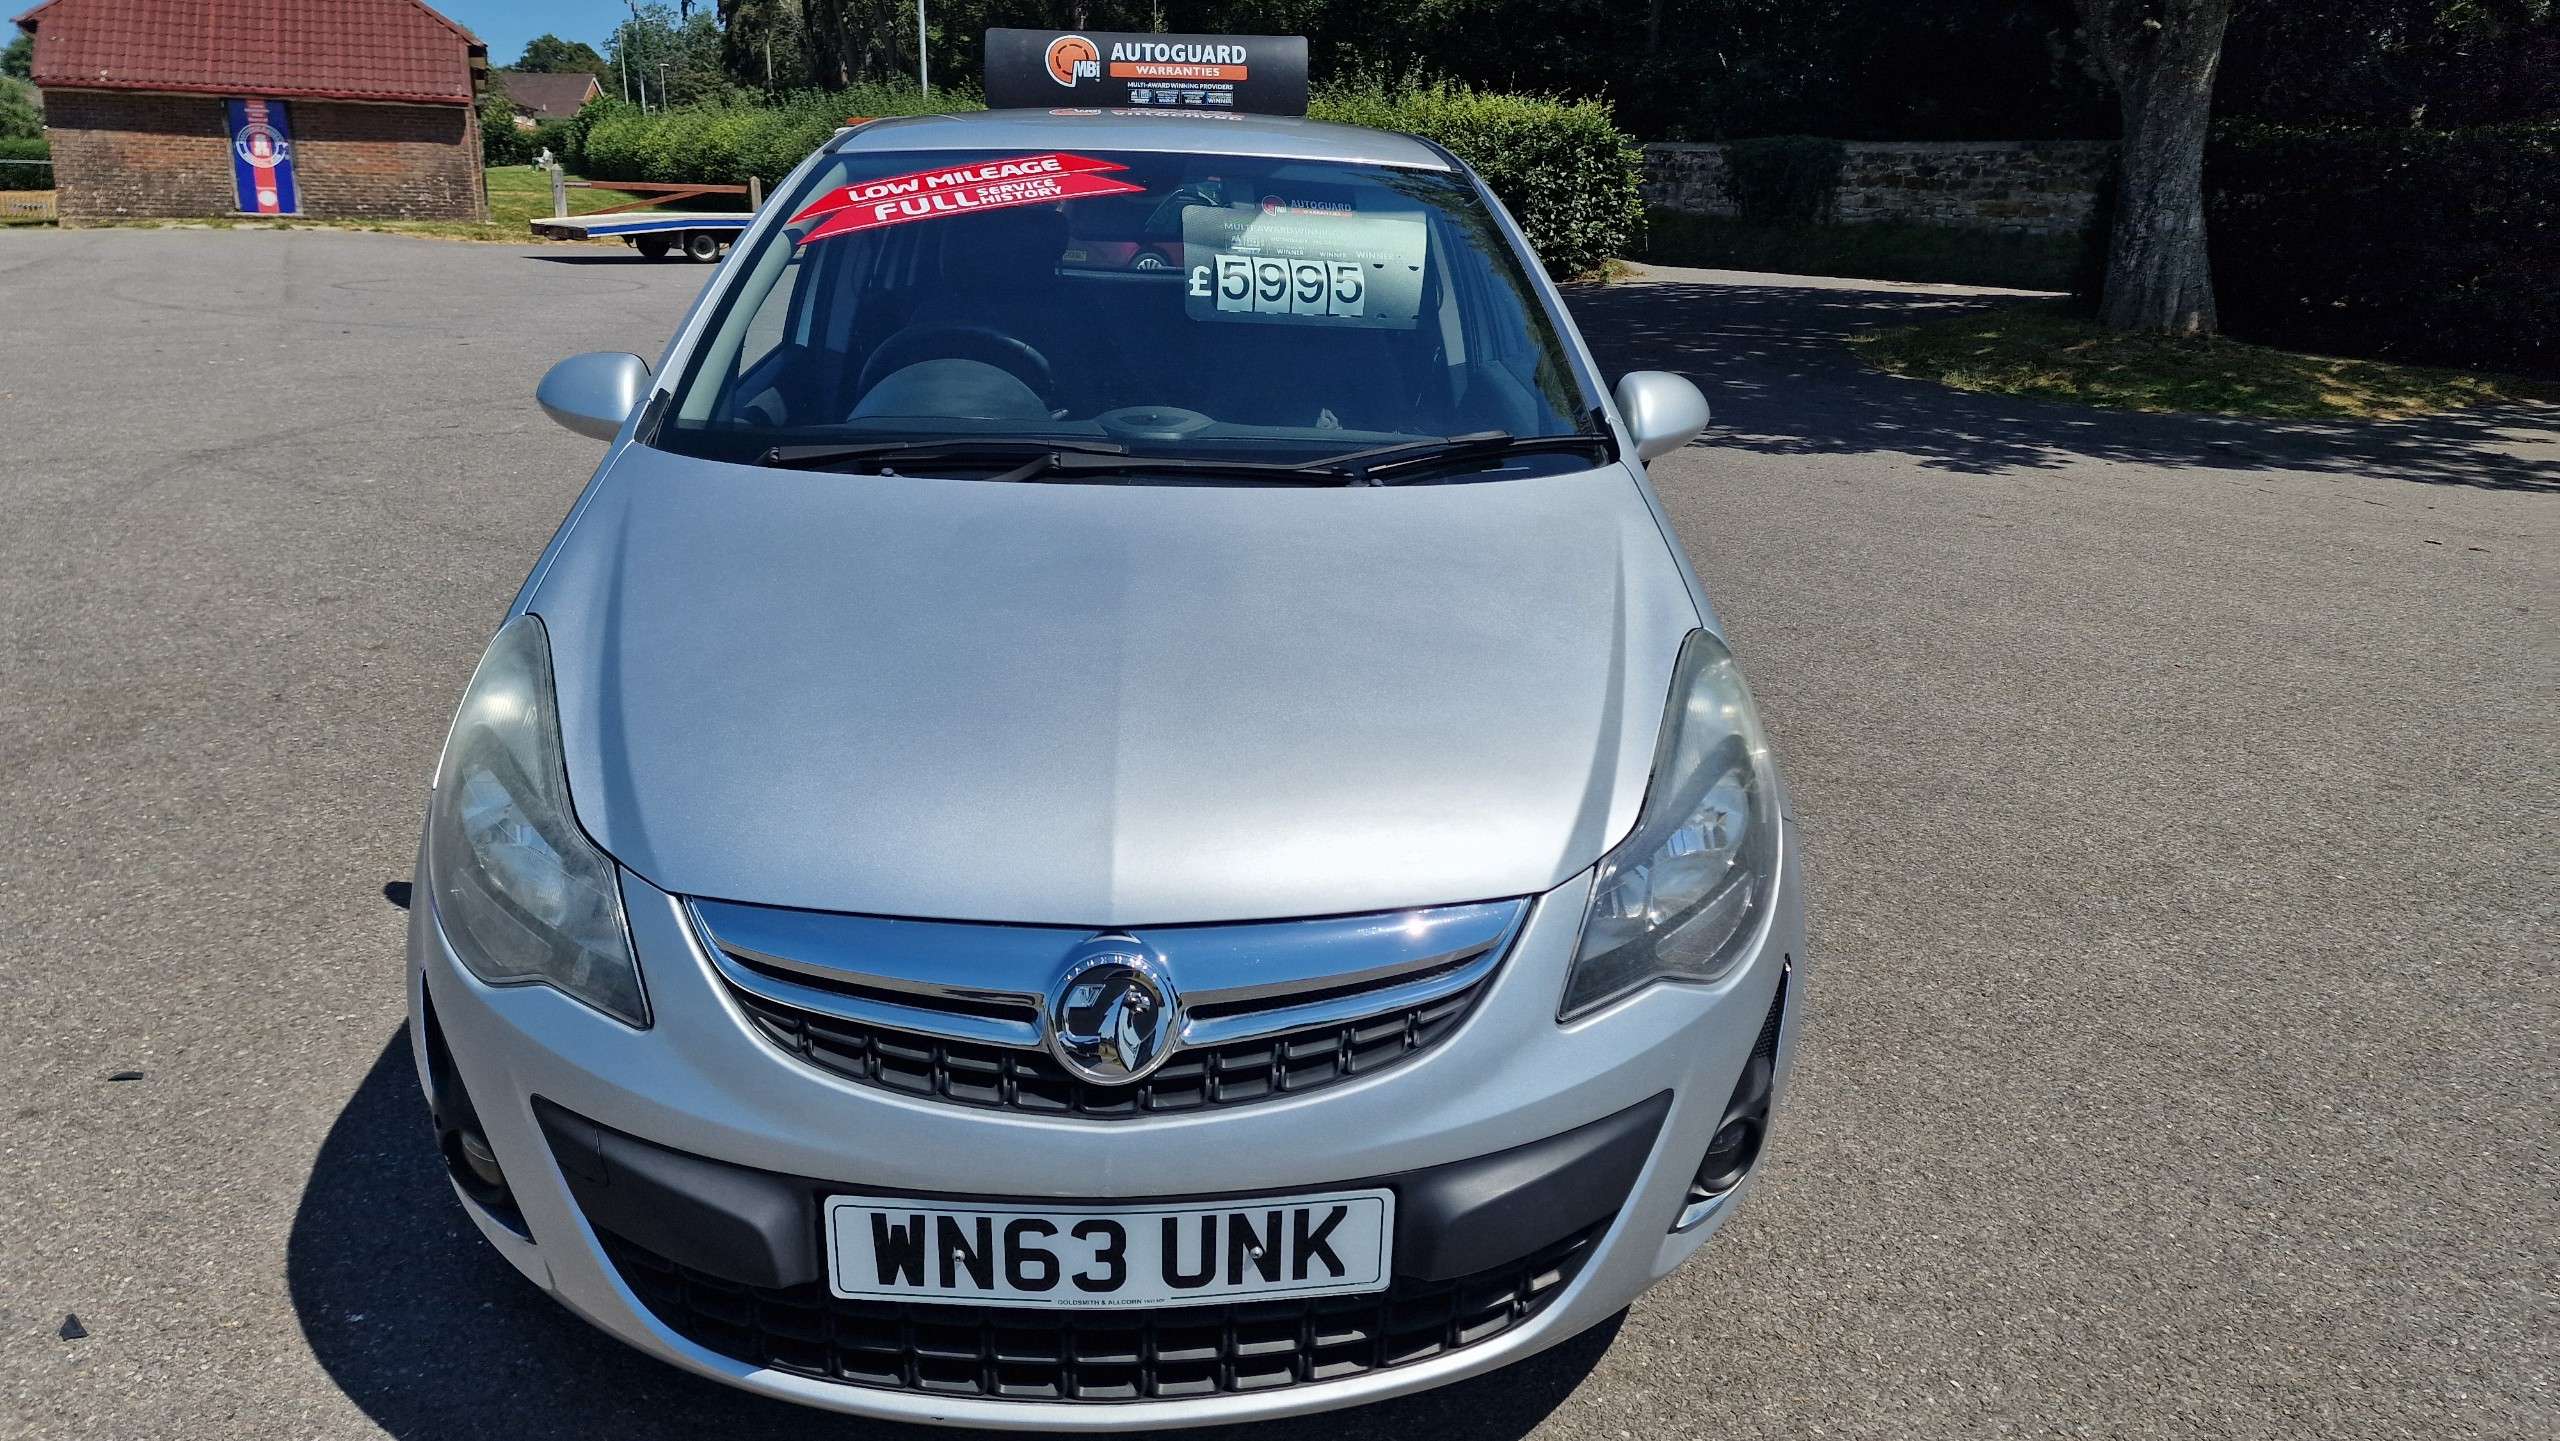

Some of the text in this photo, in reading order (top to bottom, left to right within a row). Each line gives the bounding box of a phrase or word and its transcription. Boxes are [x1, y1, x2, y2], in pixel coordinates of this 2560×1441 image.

[1110, 42, 1247, 64] AUTOGUARD
[1136, 65, 1220, 77] WARRANTIES
[849, 158, 1062, 202] LOW MILEAGE
[976, 178, 1057, 197] SERVICE
[979, 186, 1062, 205] HISTORY
[1290, 199, 1353, 212] AUTOGUARD
[874, 192, 979, 221] FULL
[870, 1205, 1348, 1293] WN63 UNK
